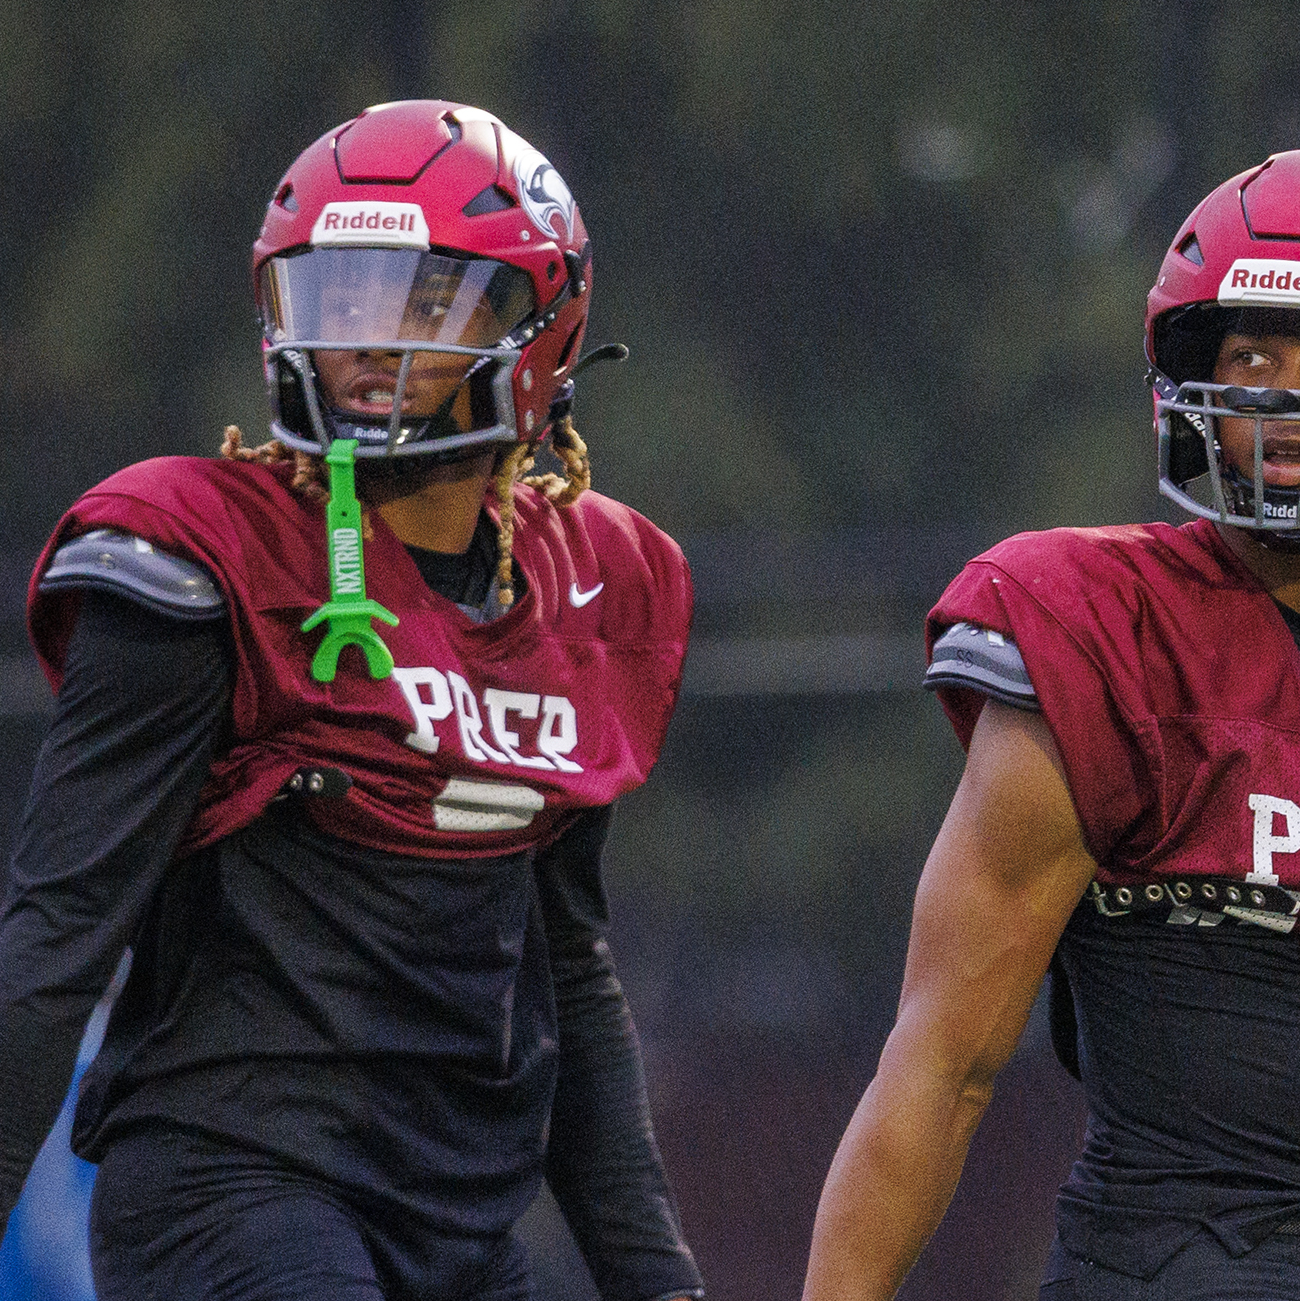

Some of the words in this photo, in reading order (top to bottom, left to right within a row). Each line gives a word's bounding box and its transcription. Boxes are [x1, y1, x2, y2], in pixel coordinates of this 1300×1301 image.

[324, 211, 416, 232] Riddell
[354, 427, 389, 439] Ridde
[333, 528, 362, 594] NXTRND
[392, 666, 584, 773] PREP
